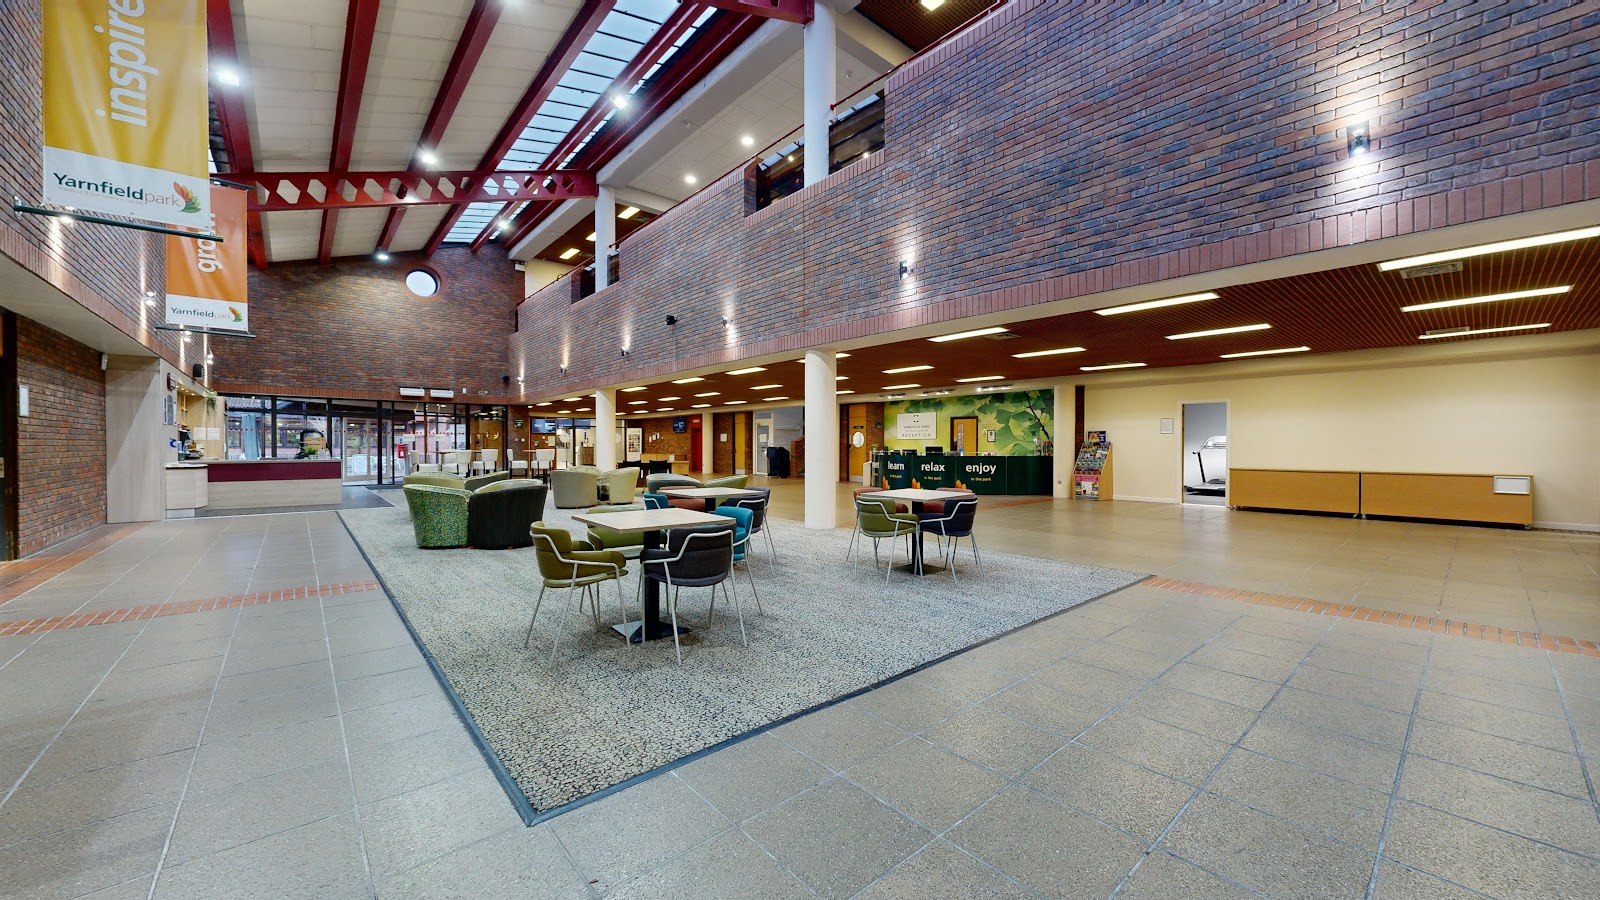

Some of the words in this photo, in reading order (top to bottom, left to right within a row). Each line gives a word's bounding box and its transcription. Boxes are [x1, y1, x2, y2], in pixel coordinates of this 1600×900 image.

[94, 0, 159, 127] inspire
[197, 212, 222, 273] gro
[888, 461, 904, 470] learn
[921, 461, 946, 472] relax
[965, 462, 997, 475] enjoy
